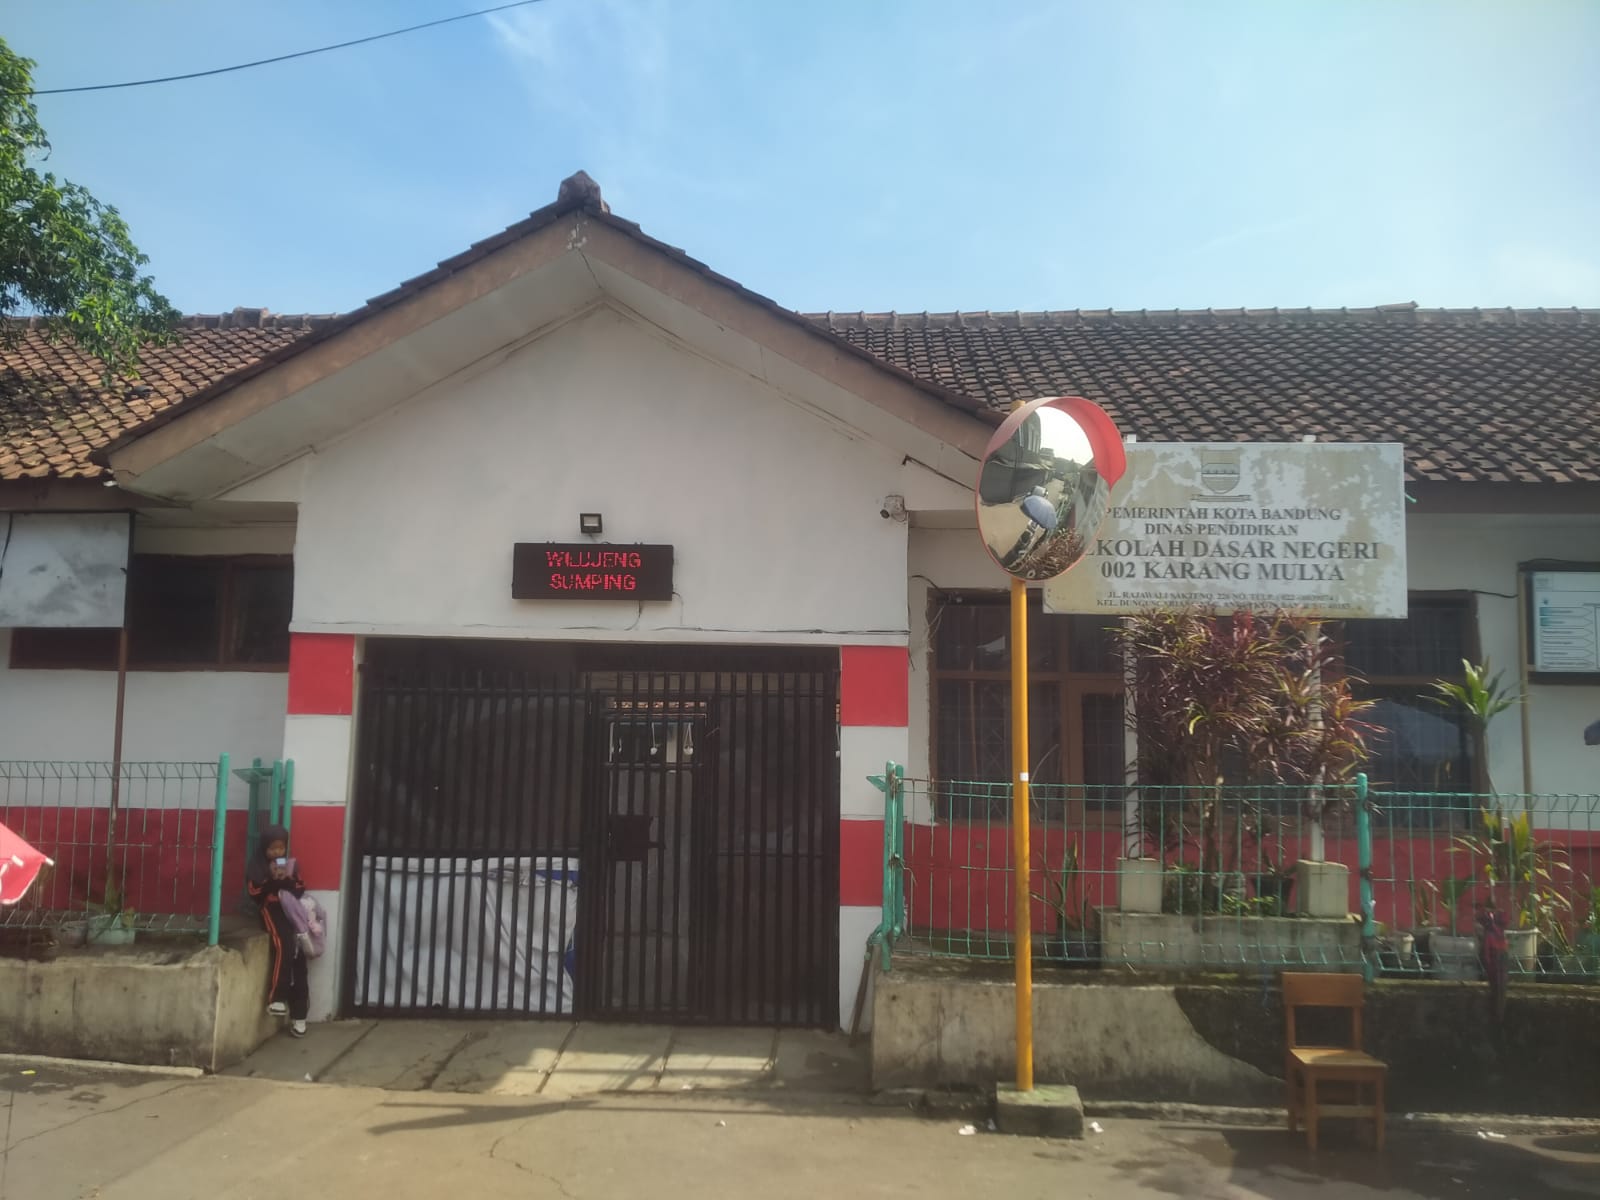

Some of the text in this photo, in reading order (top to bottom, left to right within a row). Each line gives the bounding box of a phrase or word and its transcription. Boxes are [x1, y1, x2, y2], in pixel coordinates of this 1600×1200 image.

[1213, 507, 1257, 520] KOTA
[1261, 508, 1342, 521] BANDUNG
[1144, 523, 1298, 536] DINAS PENDIDIKAN
[1192, 540, 1275, 558] DASAR
[1283, 541, 1379, 559] NEGERI
[1101, 561, 1345, 581] 002 KARANG MULYA
[549, 573, 636, 590] SUMPING
